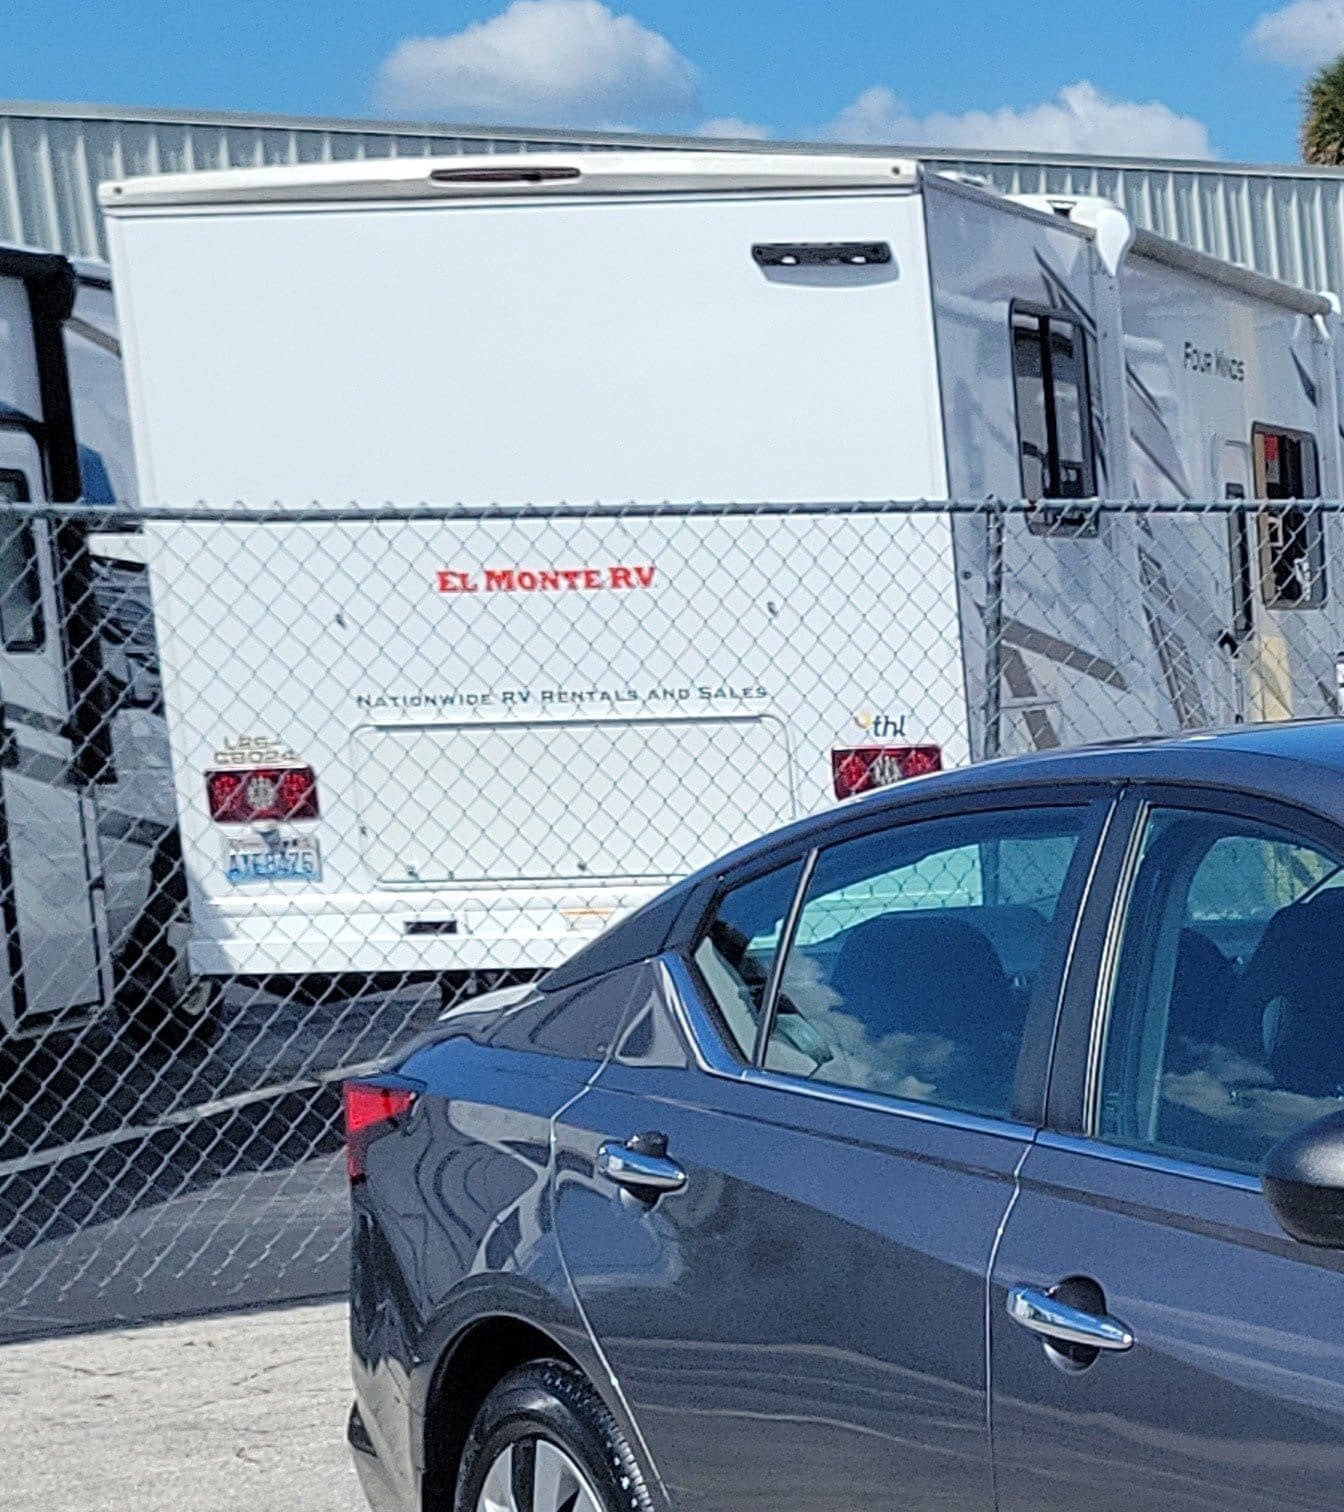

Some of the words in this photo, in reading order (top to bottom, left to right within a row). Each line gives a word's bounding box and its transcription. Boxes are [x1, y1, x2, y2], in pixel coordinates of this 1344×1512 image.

[437, 570, 478, 593] EL
[485, 568, 602, 592] MONTE
[608, 566, 656, 590] RV
[357, 693, 493, 709] NATIONWIDE
[502, 690, 531, 704] RV
[540, 689, 639, 704] RENTALS
[649, 686, 691, 701] AND
[698, 686, 768, 700] SALES
[873, 715, 906, 737] thl
